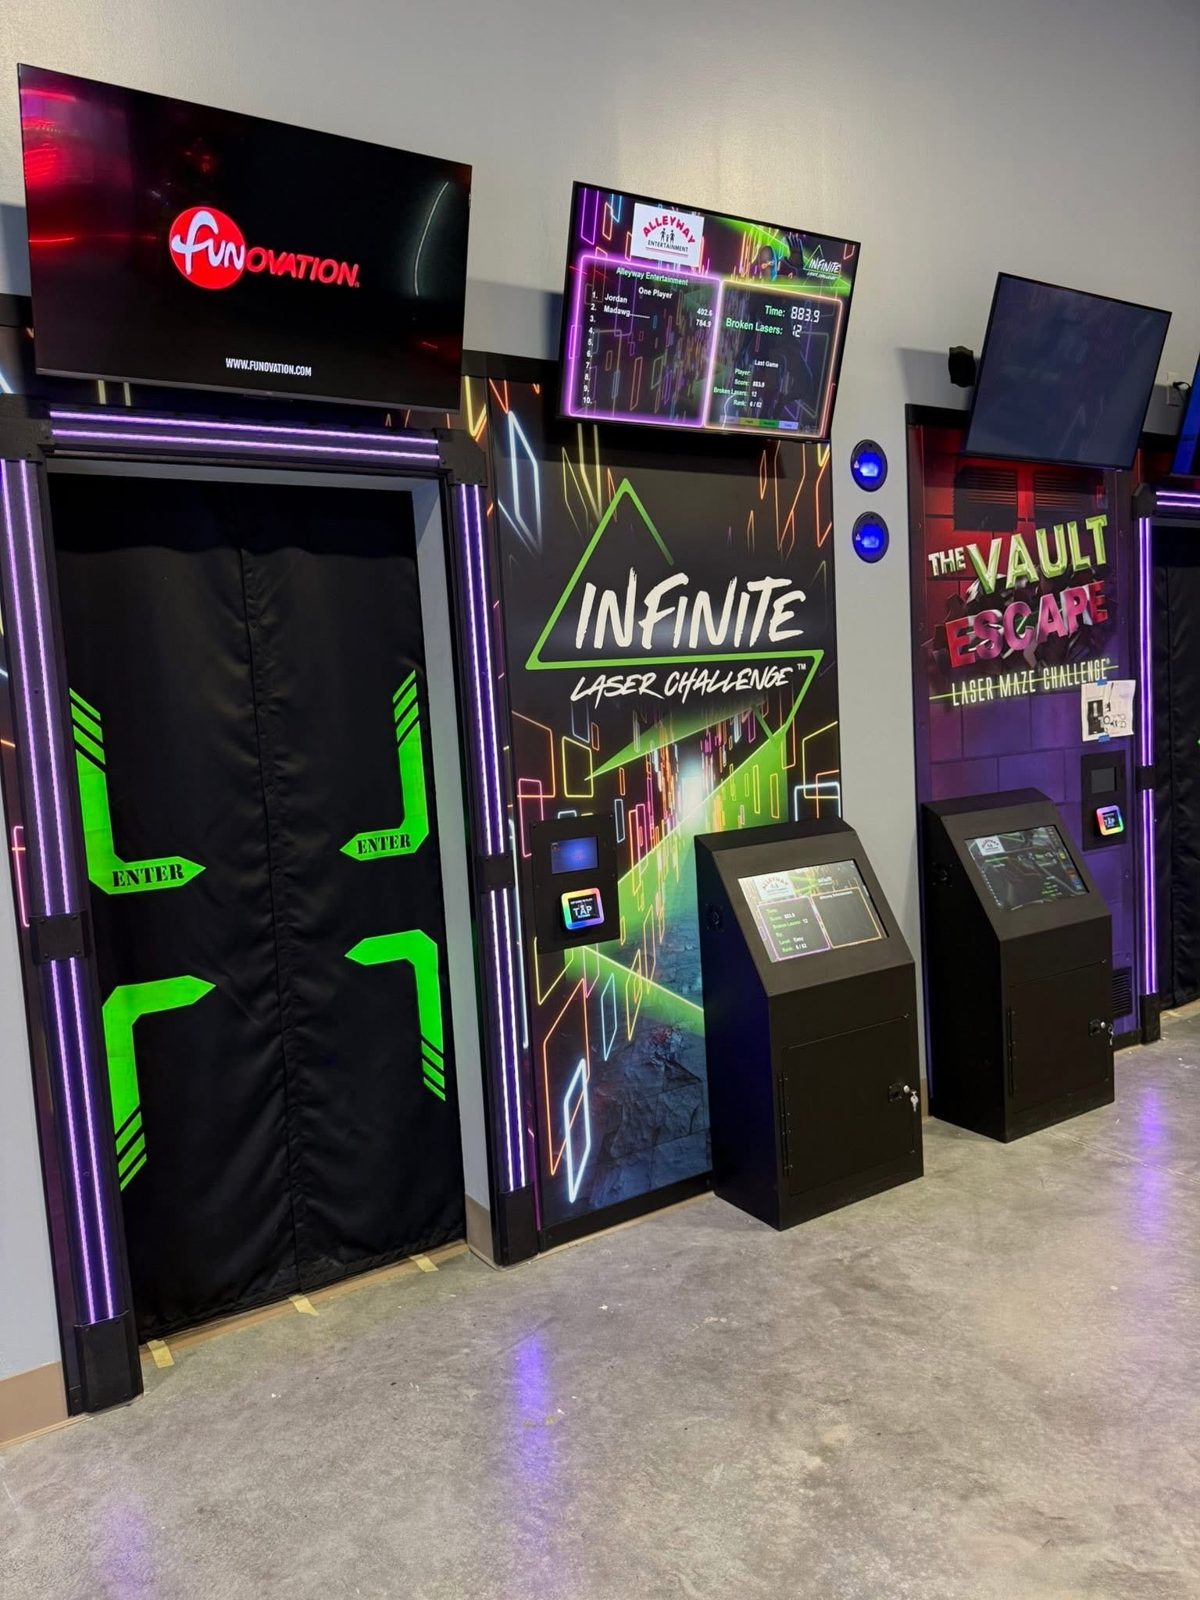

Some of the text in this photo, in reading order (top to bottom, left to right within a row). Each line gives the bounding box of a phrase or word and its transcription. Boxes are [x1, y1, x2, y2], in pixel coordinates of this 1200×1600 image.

[643, 215, 695, 243] ALLEYWAY
[647, 240, 689, 253] ENTERTAINMENT
[808, 257, 841, 273] INFINITE
[616, 267, 688, 286] Alleyway Entertainment
[591, 291, 598, 299] 1.
[604, 293, 628, 304] Jordan
[638, 287, 673, 299] One Player
[590, 303, 597, 311] 2.
[765, 305, 820, 323] Time: 883.9
[589, 315, 596, 323] 3.
[725, 317, 803, 338] Broken Lasers: 12
[225, 357, 312, 377] WWW.FUNOVATION.COM
[583, 396, 592, 404] 10.
[928, 514, 1108, 595] THE VAULT
[575, 566, 806, 650] INFINITE
[944, 580, 1109, 669] ESCAPE
[570, 671, 665, 710] LASER
[664, 666, 794, 704] CHALLENGE
[952, 658, 1108, 707] LASER MAZE CHALLENGE
[356, 833, 412, 855] ENTER
[111, 863, 185, 888] ENTER
[572, 904, 593, 917] TAP
